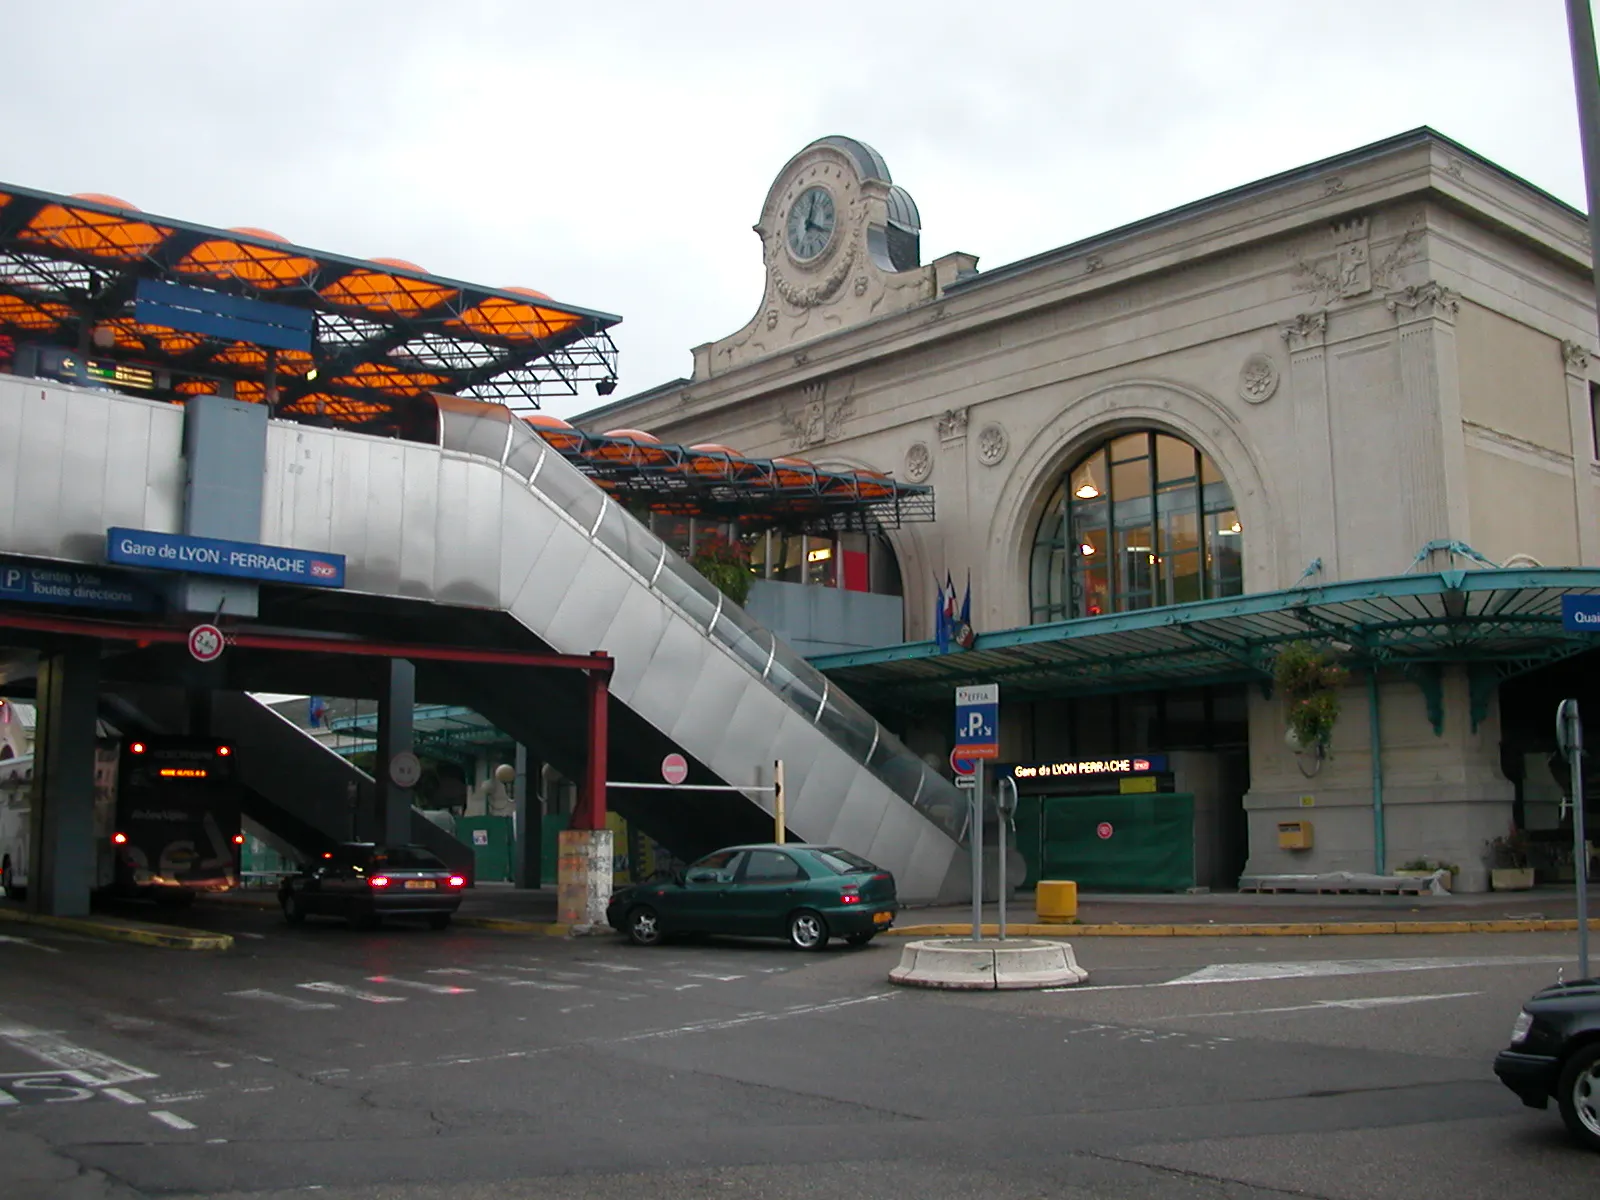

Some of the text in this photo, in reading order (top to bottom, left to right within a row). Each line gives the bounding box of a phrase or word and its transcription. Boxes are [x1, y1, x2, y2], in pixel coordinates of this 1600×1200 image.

[121, 539, 156, 557] Gare
[158, 544, 177, 559] de
[179, 546, 219, 564] LYON
[230, 552, 305, 574] PERRACHE
[7, 569, 21, 587] P
[32, 581, 133, 601] Toutes directions
[967, 691, 989, 702] EFFIA
[1014, 759, 1131, 778] Gare de LYON PERRACHE
